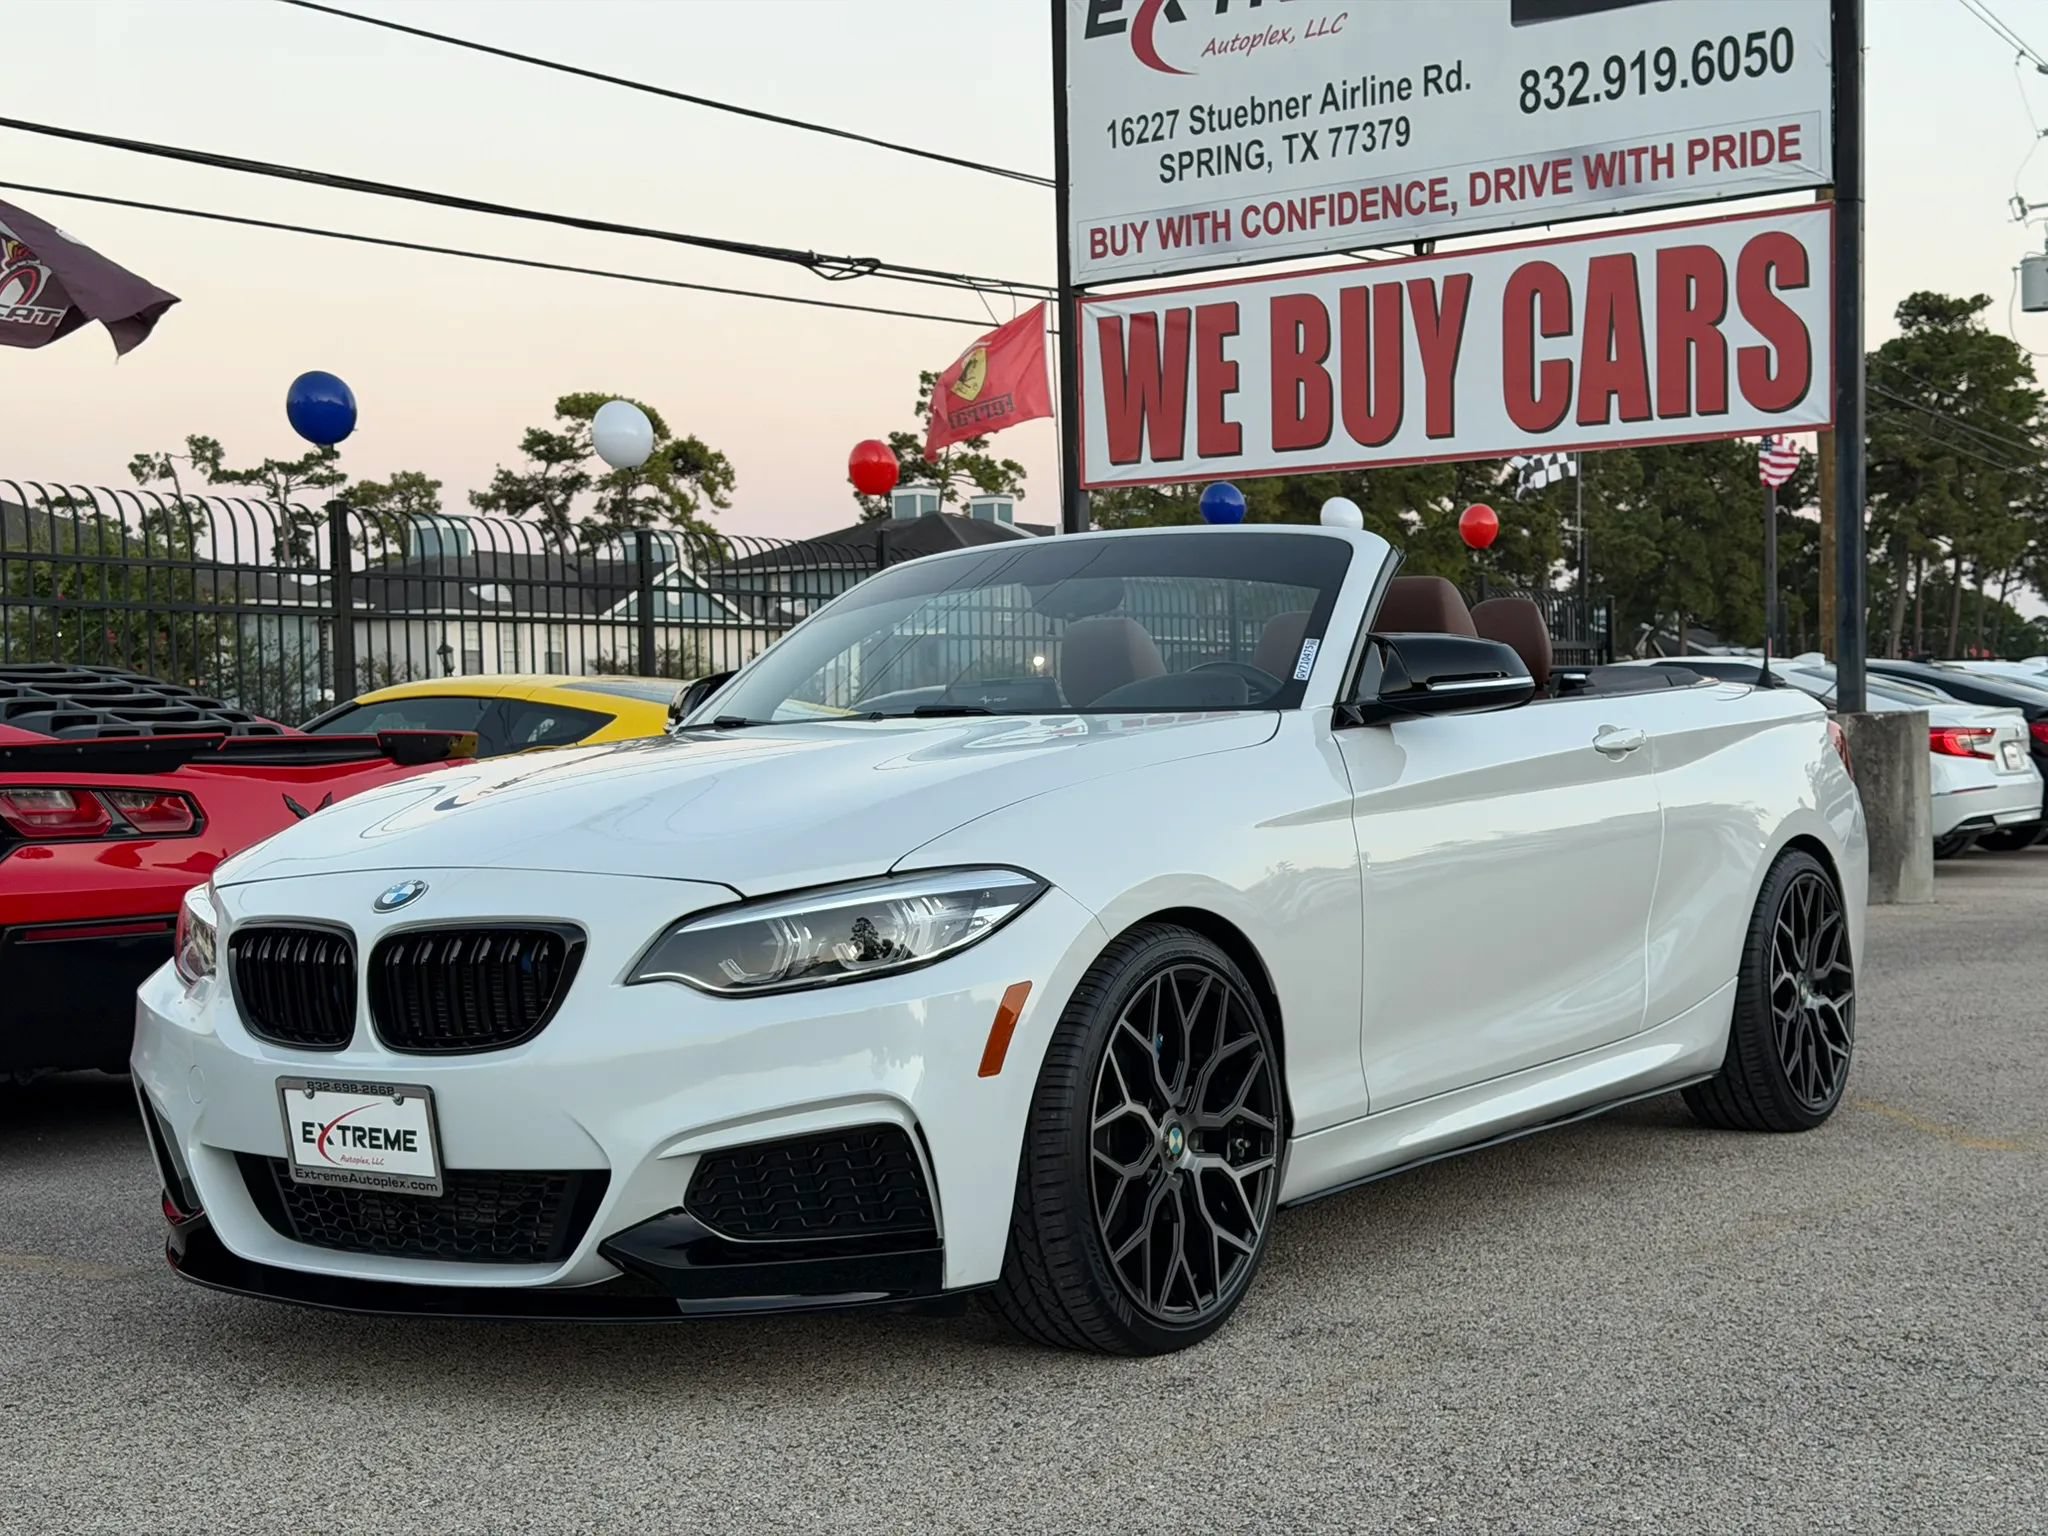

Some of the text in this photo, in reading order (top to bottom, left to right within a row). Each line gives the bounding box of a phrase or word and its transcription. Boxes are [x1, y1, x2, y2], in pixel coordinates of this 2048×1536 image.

[1201, 23, 1296, 57] Autoplex,
[1304, 12, 1348, 39] LLC
[1519, 27, 1794, 114] 832.919.6050
[1106, 59, 1472, 149] 16227 Stuebner Airline Rd.
[1159, 115, 1412, 184] SPRING, TX 77379
[1089, 123, 1802, 260] BUY WITH CONFIDENCE, DRIVE WITH PRIDE
[1097, 230, 1812, 465] WE BUY CARS
[302, 1121, 418, 1152] EXTREME
[295, 1168, 438, 1192] ExtremeAutoplex.com
